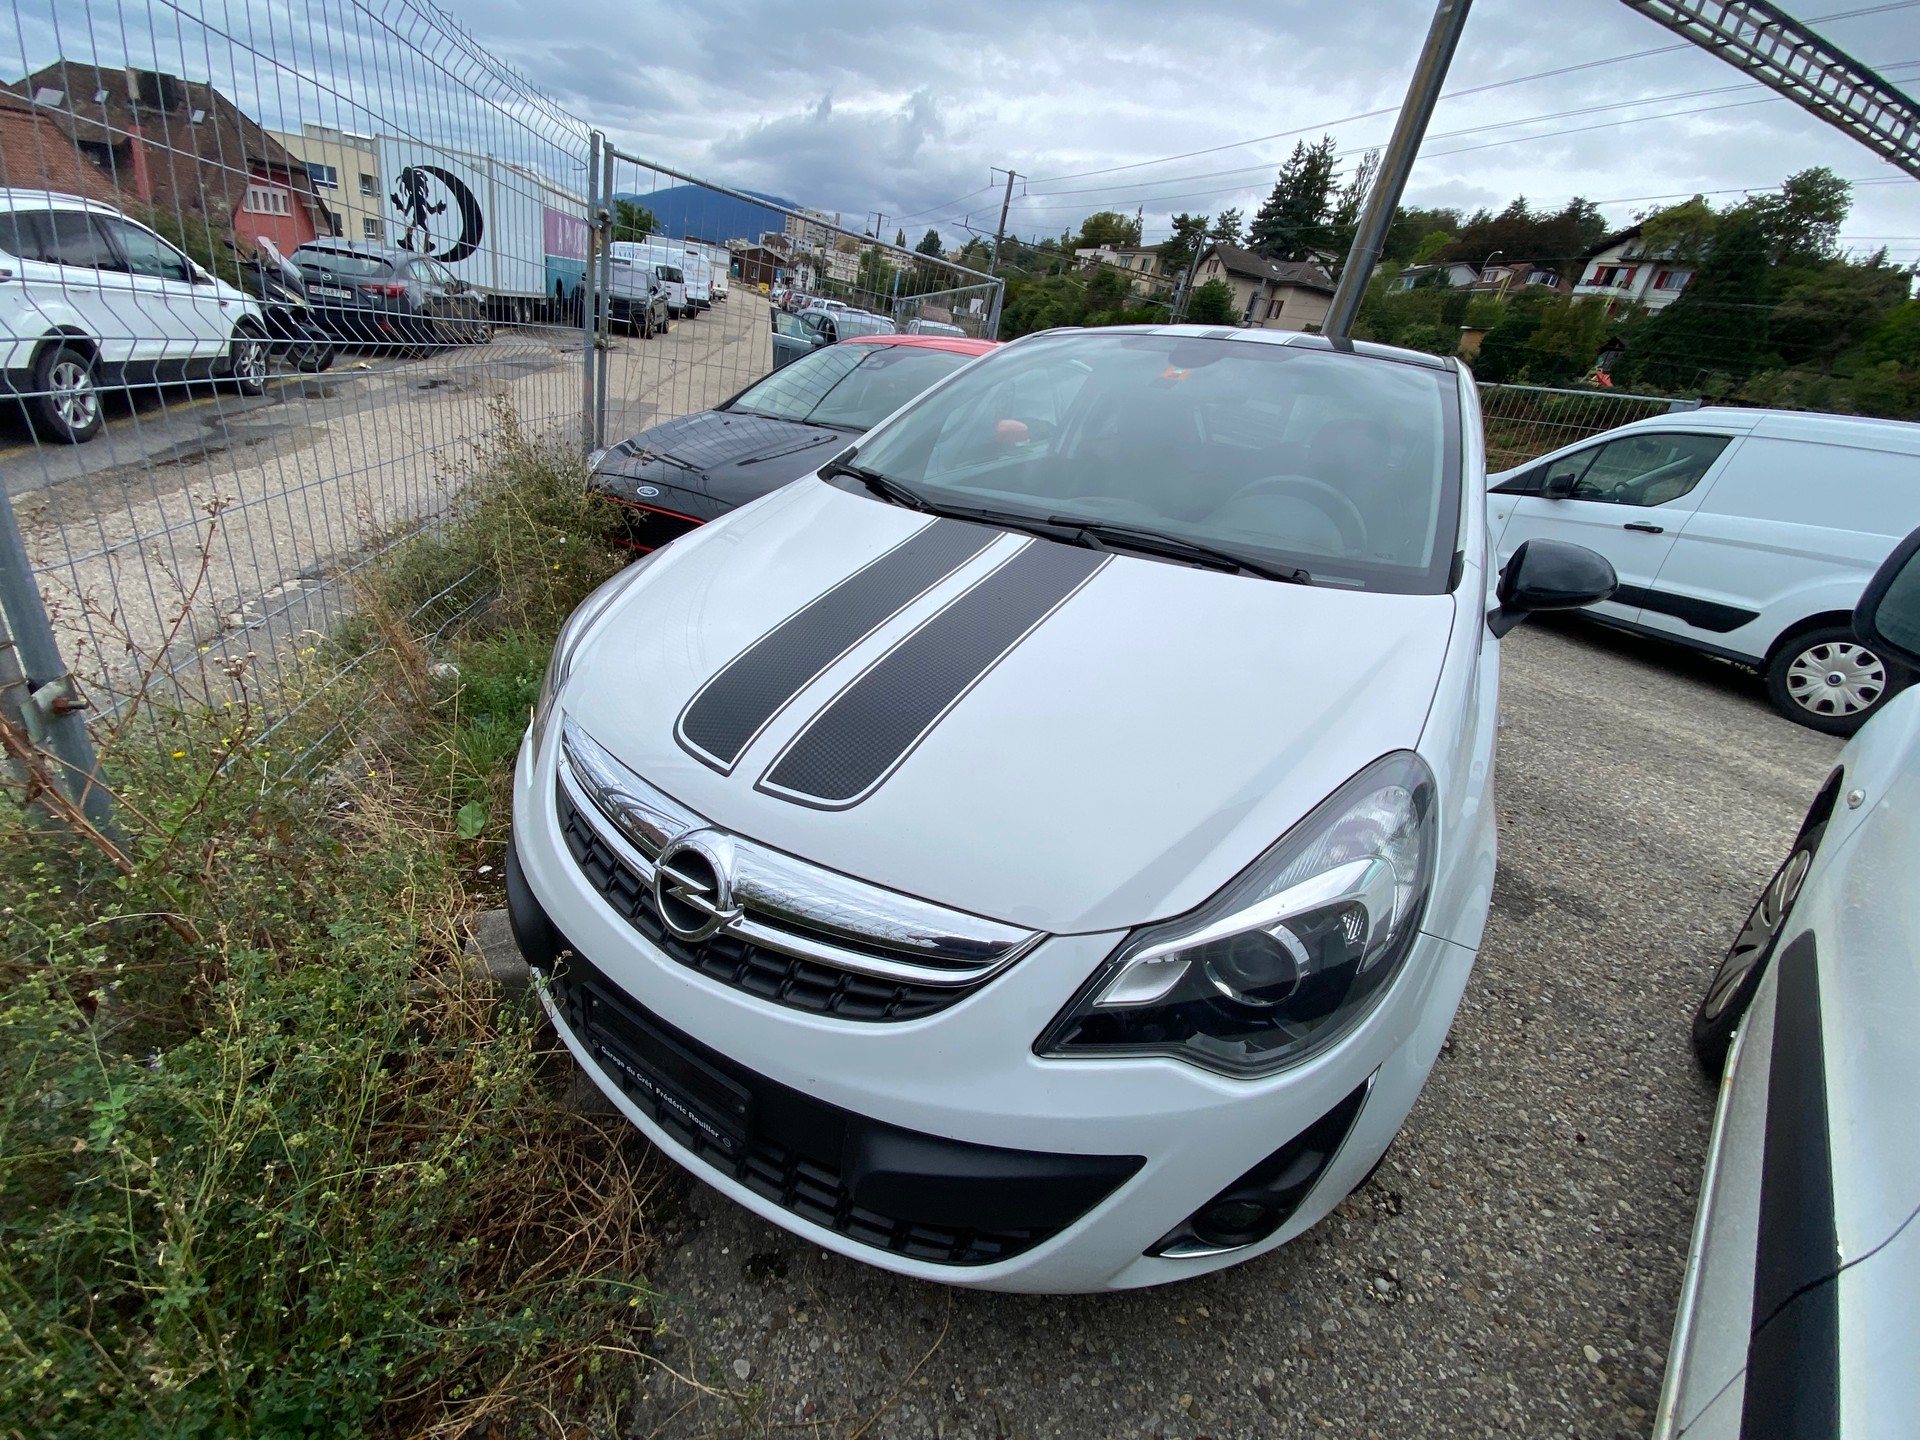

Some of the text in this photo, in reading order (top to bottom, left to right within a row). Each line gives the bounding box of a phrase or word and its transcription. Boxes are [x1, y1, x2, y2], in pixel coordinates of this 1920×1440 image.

[601, 1046, 625, 1068] Garage
[626, 1066, 636, 1077] du
[656, 1087, 687, 1115] Frédéric
